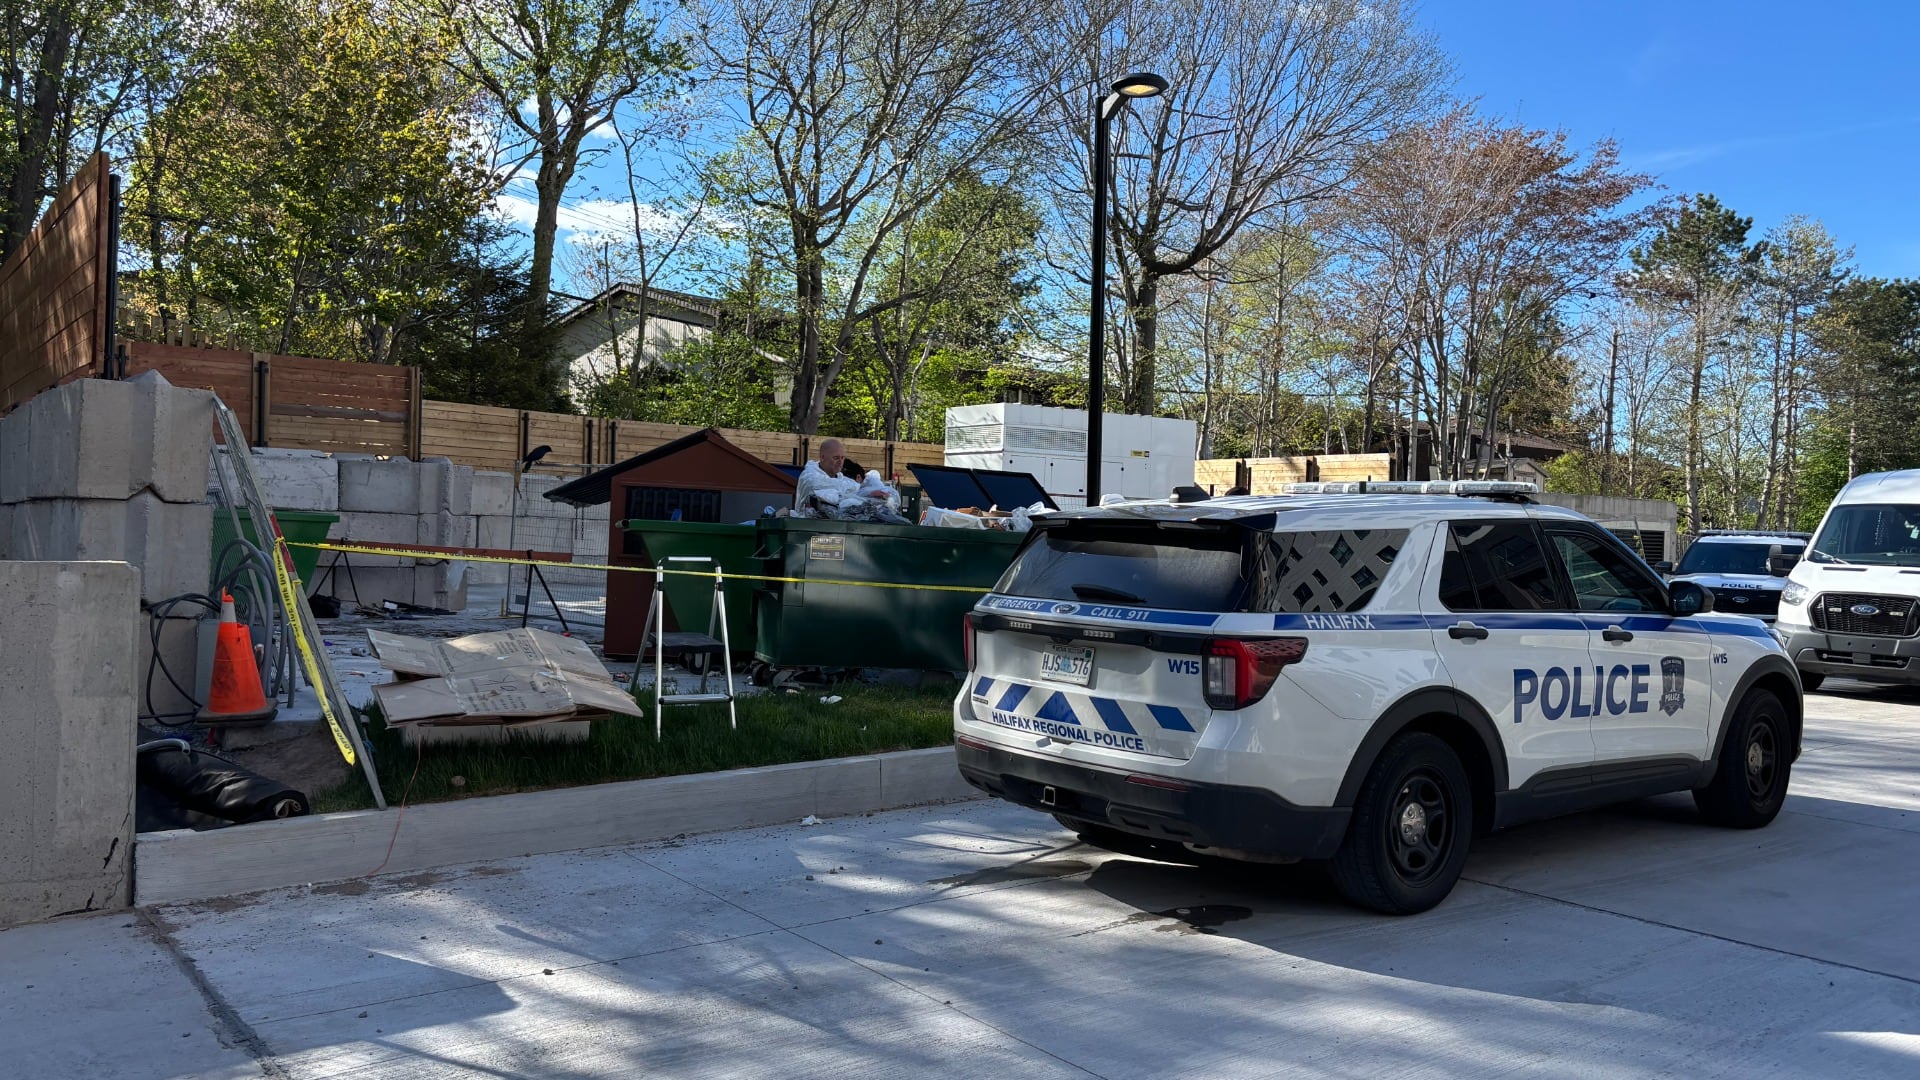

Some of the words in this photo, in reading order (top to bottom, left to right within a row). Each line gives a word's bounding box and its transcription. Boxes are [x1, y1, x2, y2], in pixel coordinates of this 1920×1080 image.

[988, 597, 1044, 611] EMERGENCY
[1090, 606, 1123, 619] CALL
[1126, 610, 1150, 621] 911
[1303, 614, 1377, 630] HALIFAX
[1042, 653, 1061, 672] HJS
[1072, 656, 1090, 676] 576
[1168, 658, 1200, 675] W15
[1713, 653, 1728, 665] W15
[1512, 663, 1651, 724] POLICE
[991, 711, 1032, 731] HALIFAX
[1033, 719, 1092, 743] REGIONAL
[1094, 731, 1145, 751] POLICE
